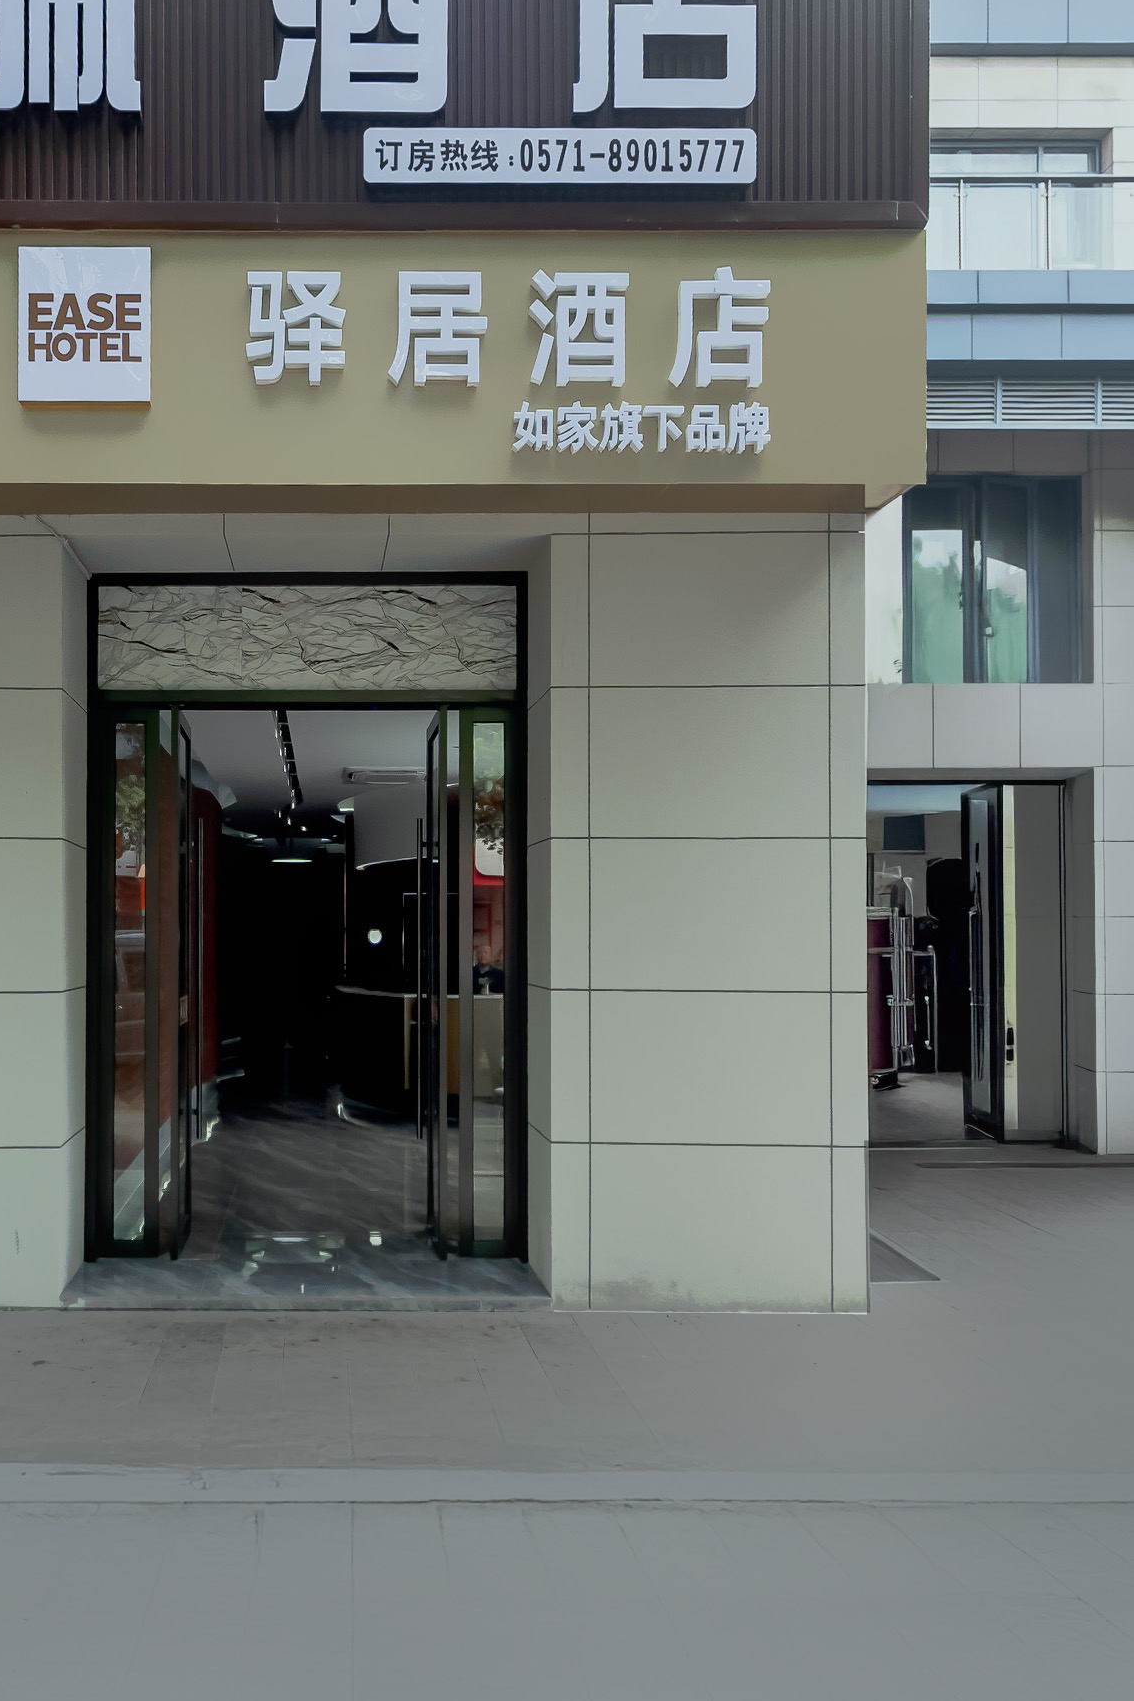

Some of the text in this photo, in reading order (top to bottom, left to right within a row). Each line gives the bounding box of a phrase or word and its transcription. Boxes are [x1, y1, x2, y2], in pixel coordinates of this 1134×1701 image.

[27, 292, 142, 331] EASE
[245, 266, 772, 389] 驿居酒店
[27, 331, 143, 363] HOTEL
[511, 400, 772, 455] 如家旗下品牌
